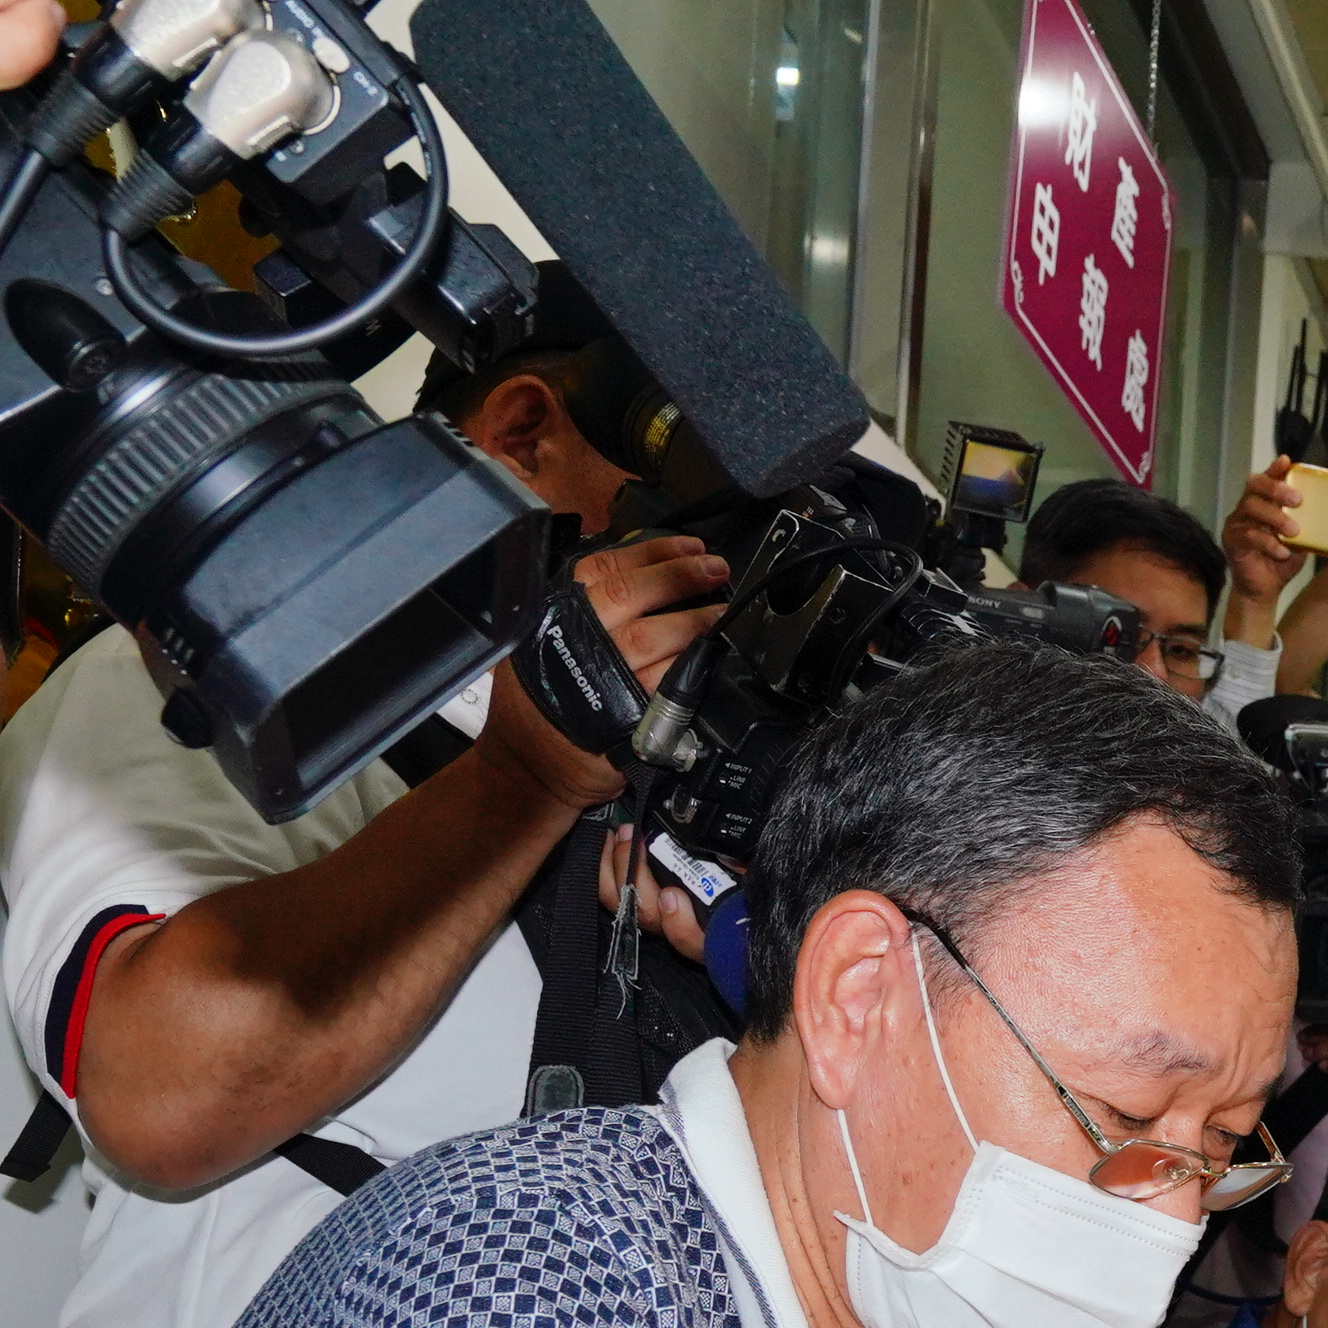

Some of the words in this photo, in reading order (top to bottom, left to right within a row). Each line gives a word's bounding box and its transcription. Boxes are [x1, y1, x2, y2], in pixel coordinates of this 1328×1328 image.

[1064, 71, 1140, 268] 財產
[968, 596, 1001, 609] SONY
[547, 625, 603, 712] Panasonic
